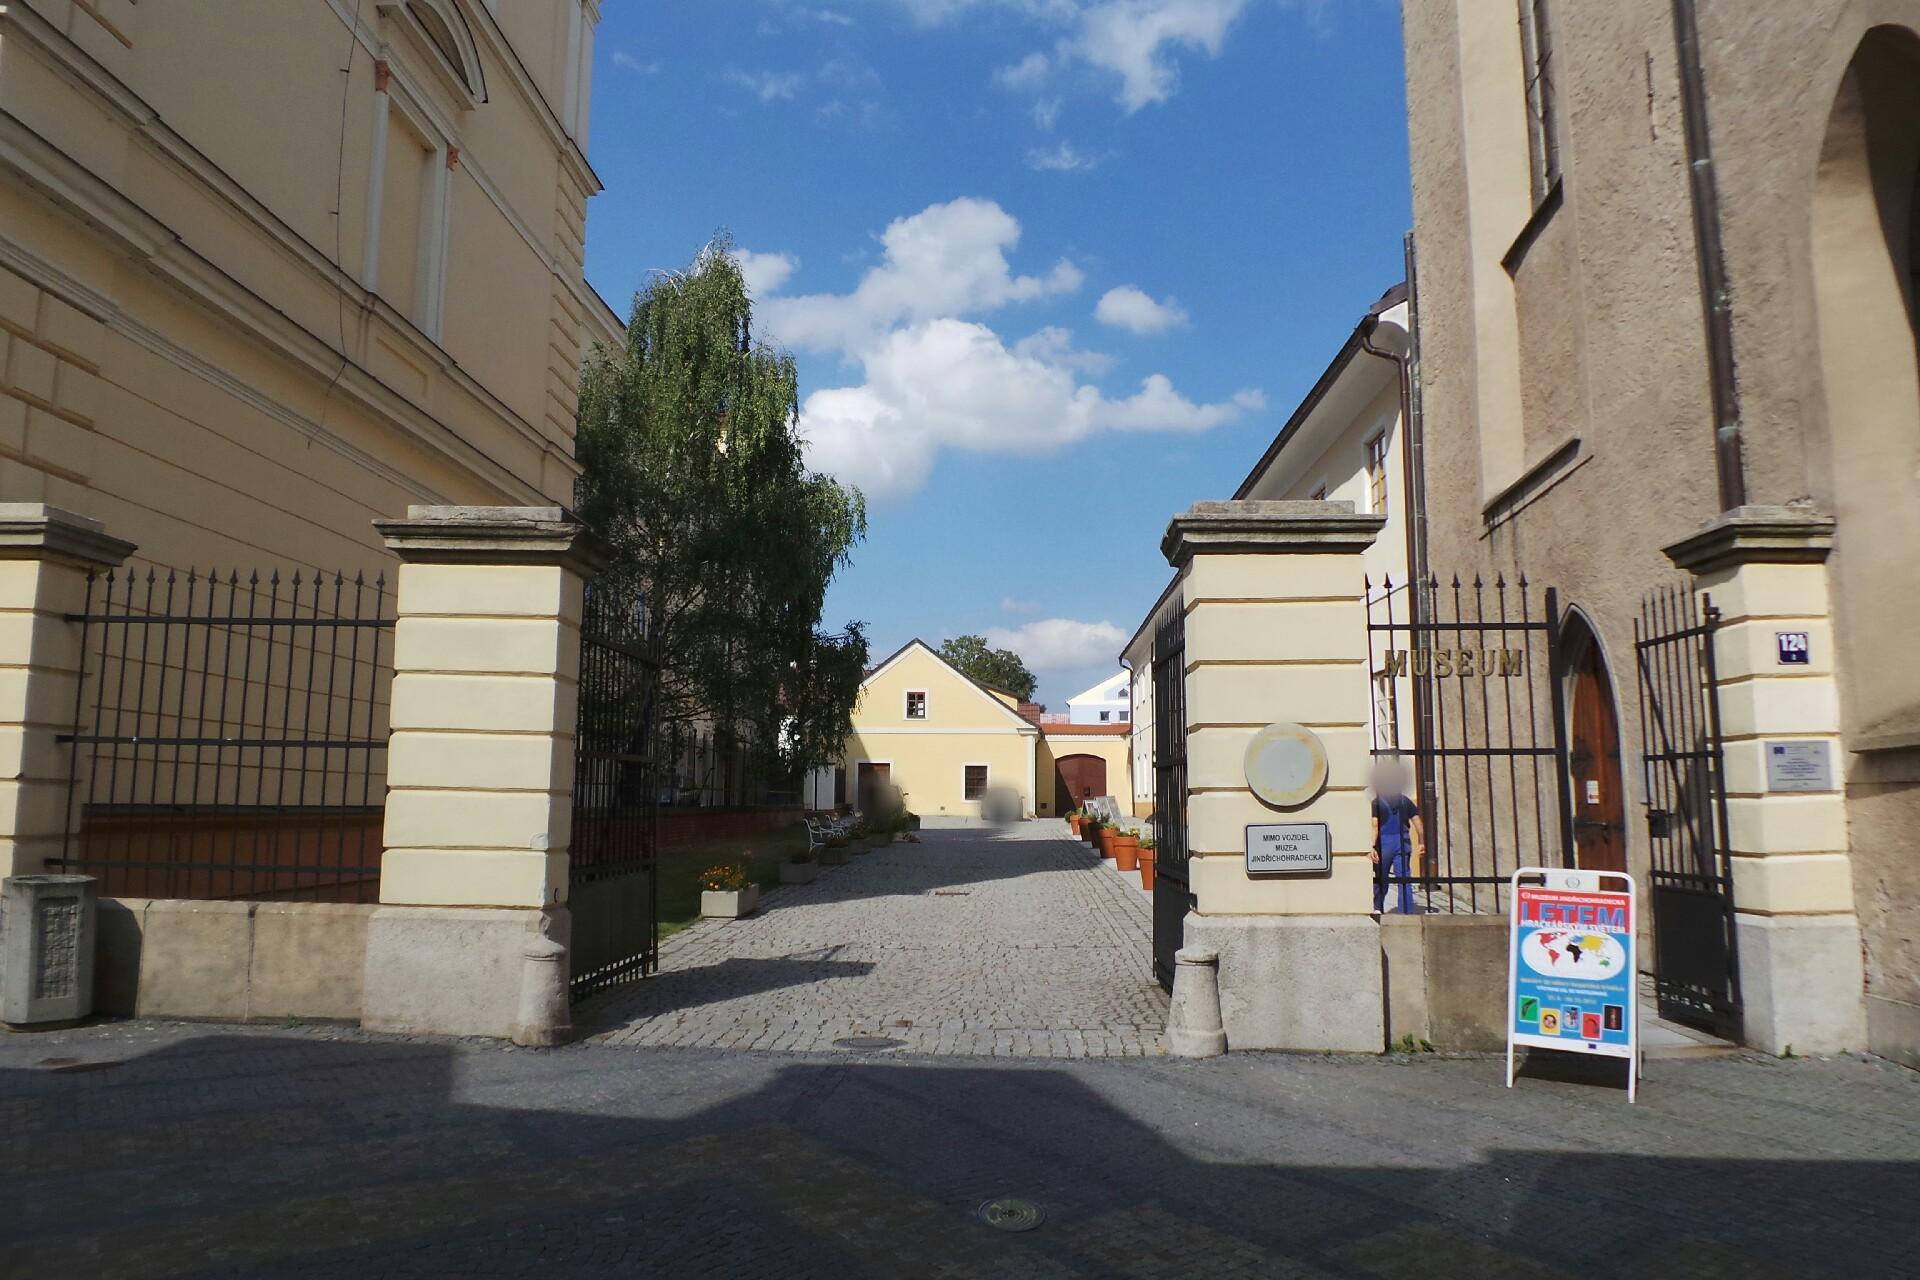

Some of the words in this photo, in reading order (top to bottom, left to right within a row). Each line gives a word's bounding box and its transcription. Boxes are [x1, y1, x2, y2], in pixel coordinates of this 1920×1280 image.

[1780, 634, 1806, 651] 124
[1384, 649, 1522, 678] MUSEUM
[1282, 833, 1310, 841] VOZIDEL
[1275, 844, 1298, 852] MUZEA
[1251, 854, 1323, 863] JINDŘICHOHRADECKA
[1521, 902, 1625, 927] LETEM
